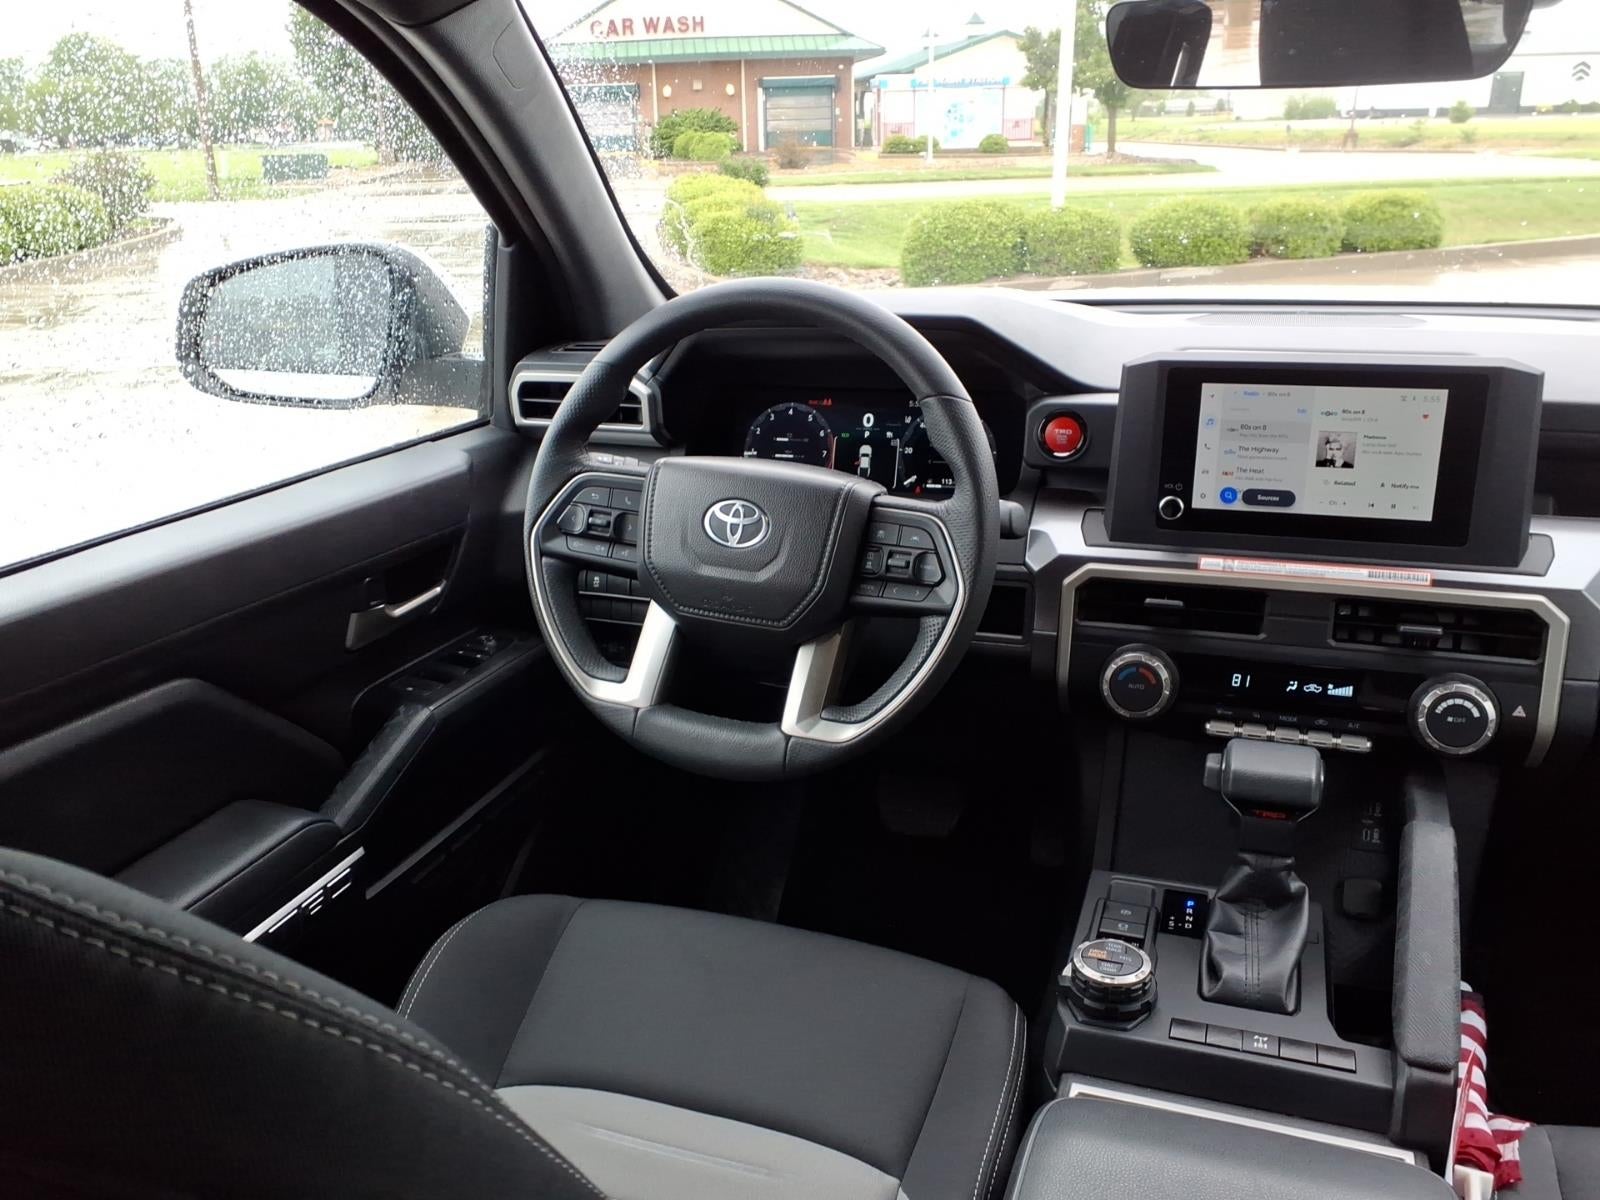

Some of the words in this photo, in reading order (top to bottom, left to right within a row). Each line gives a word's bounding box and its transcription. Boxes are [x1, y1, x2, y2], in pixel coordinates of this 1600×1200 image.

[590, 18, 634, 38] CAR
[643, 16, 704, 34] WASH
[770, 413, 775, 421] 3
[808, 414, 814, 422] 5
[863, 412, 874, 427] 0
[756, 427, 761, 435] 2
[819, 429, 825, 437] 6
[864, 430, 870, 438] P
[822, 450, 828, 458] 7
[1251, 446, 1280, 455] Highway
[1231, 674, 1251, 688] 81
